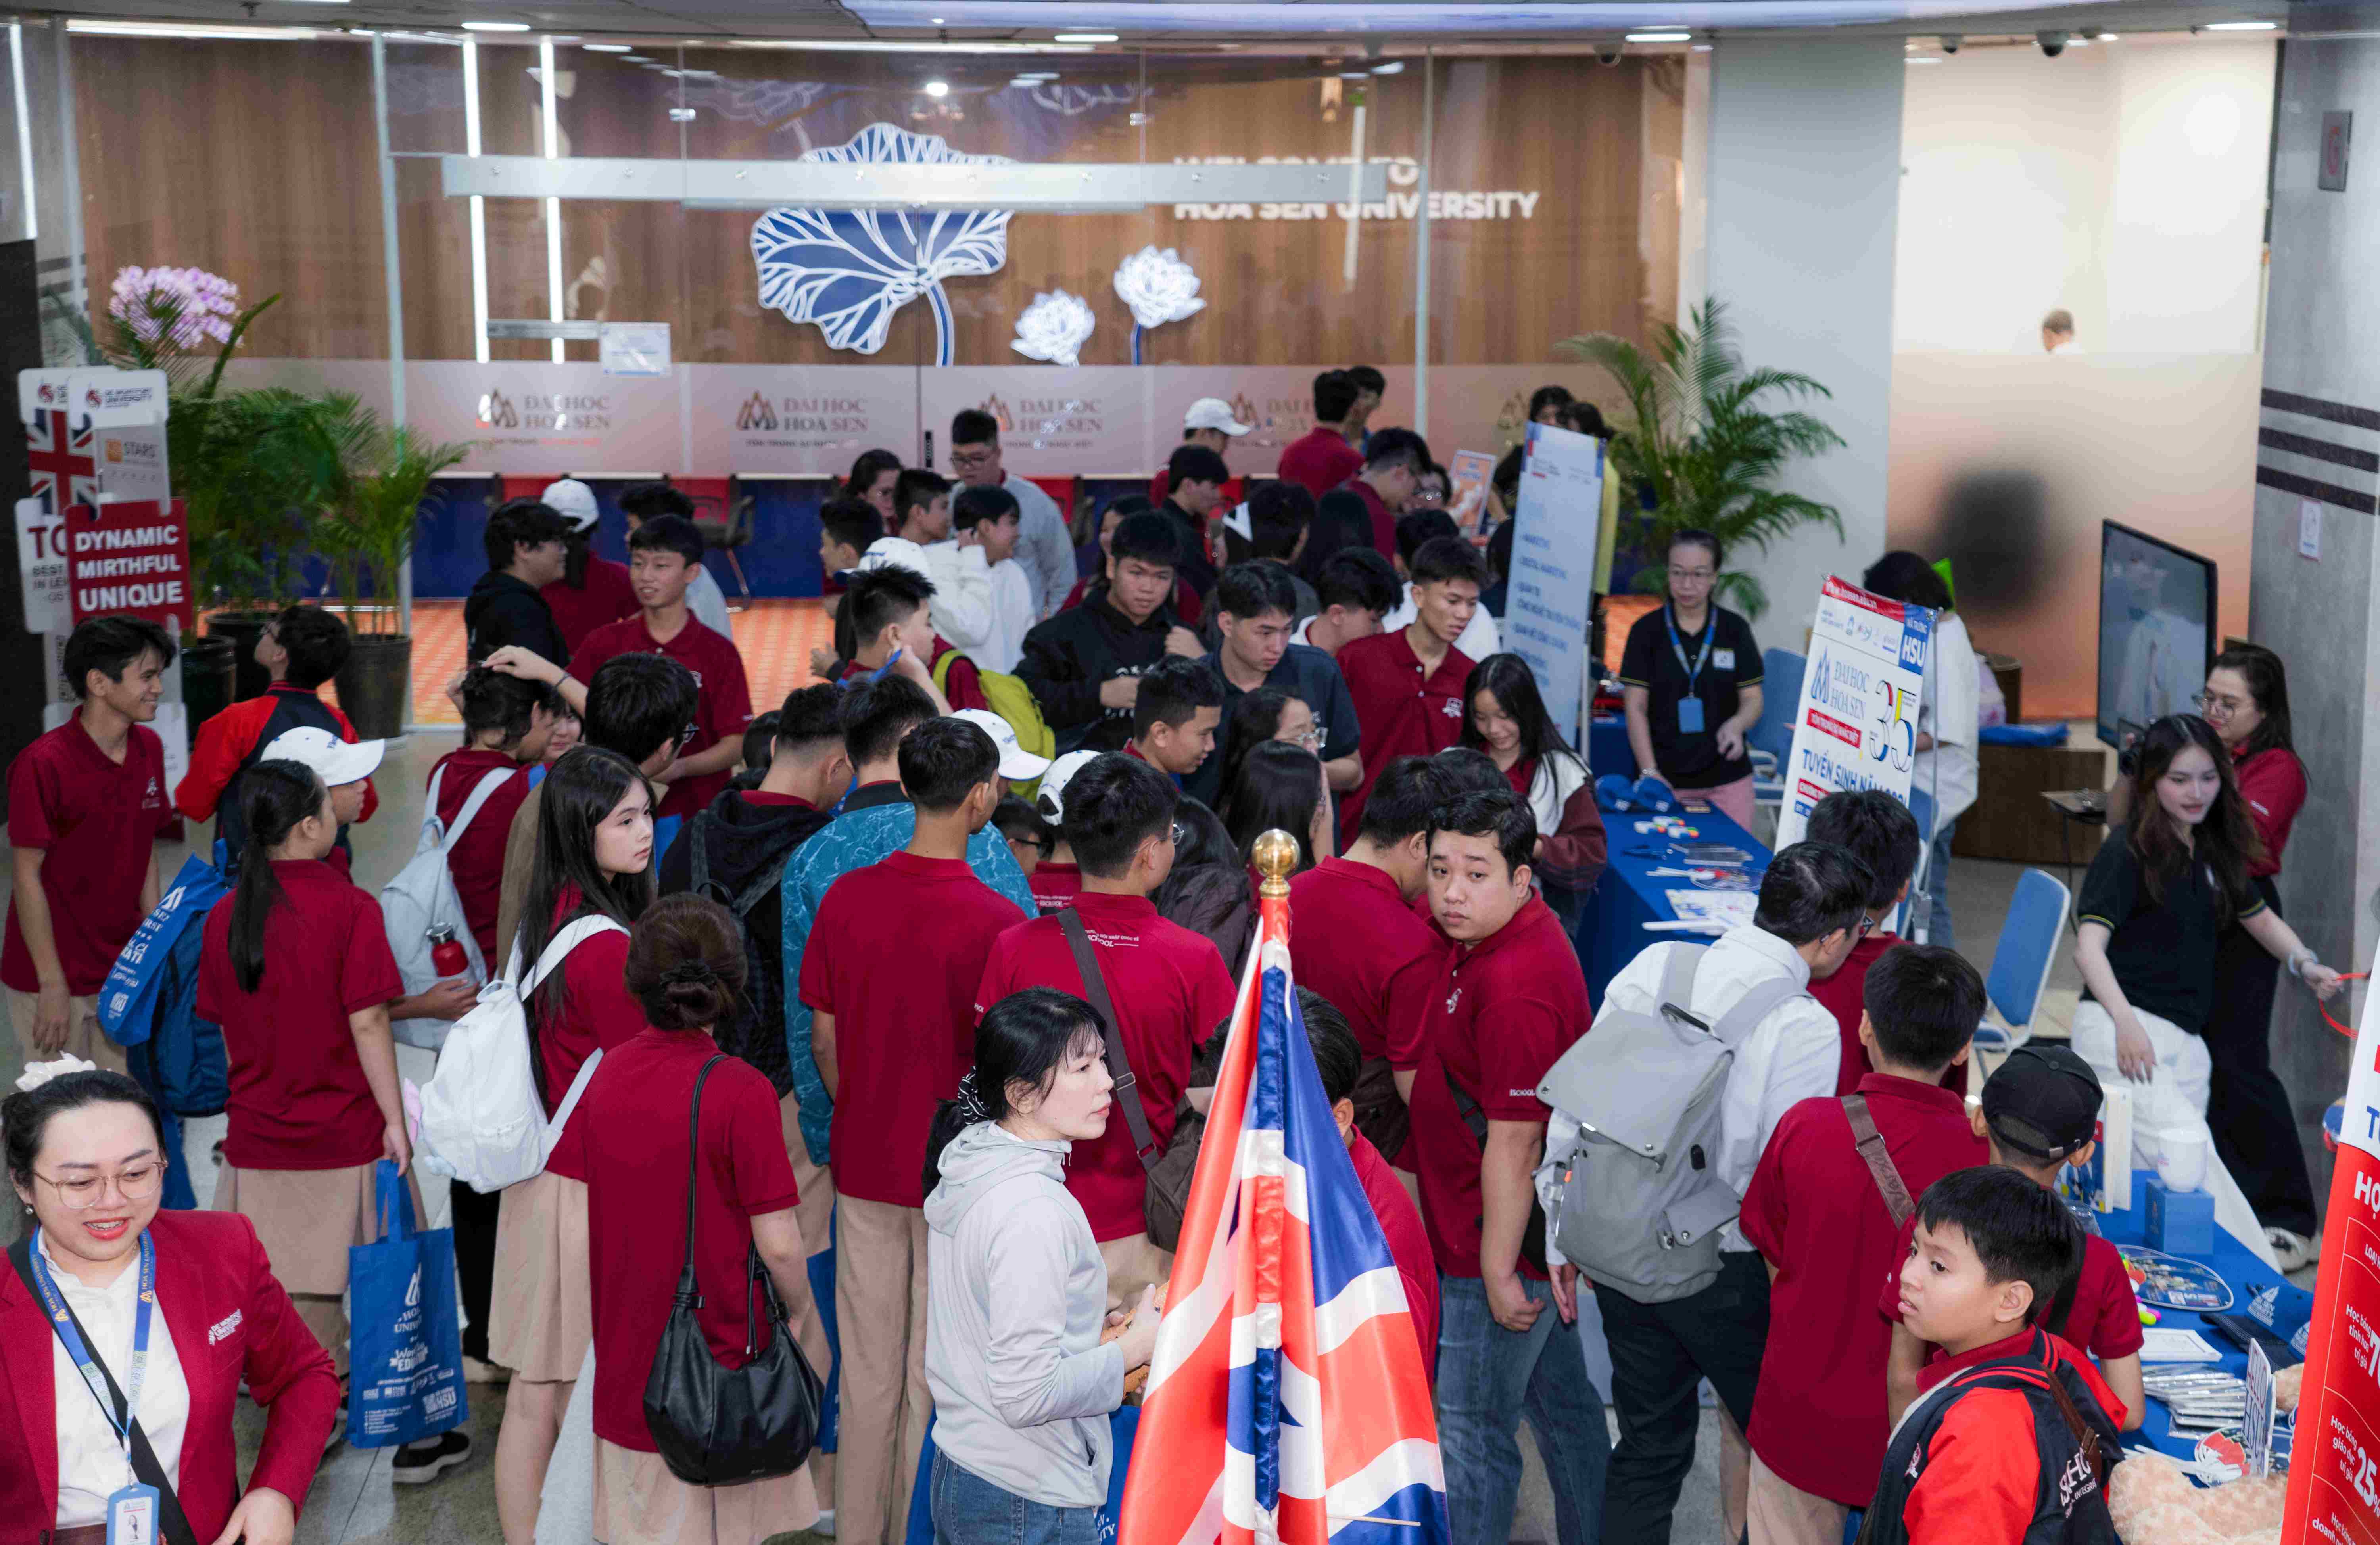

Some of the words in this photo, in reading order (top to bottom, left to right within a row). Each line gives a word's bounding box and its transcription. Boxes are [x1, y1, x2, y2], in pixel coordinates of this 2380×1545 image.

[75, 525, 179, 552] DYNAMIC
[77, 553, 182, 579] MIRTHFUL
[80, 580, 184, 611] UNIQUE
[1902, 634, 1926, 667] HSU
[2367, 1105, 2380, 1144] T
[2346, 1303, 2360, 1323] Học
[2330, 1415, 2345, 1434] Học
[2332, 1437, 2347, 1455] giáo
[2347, 1449, 2355, 1466] dục
[2312, 1518, 2336, 1544] doanh
